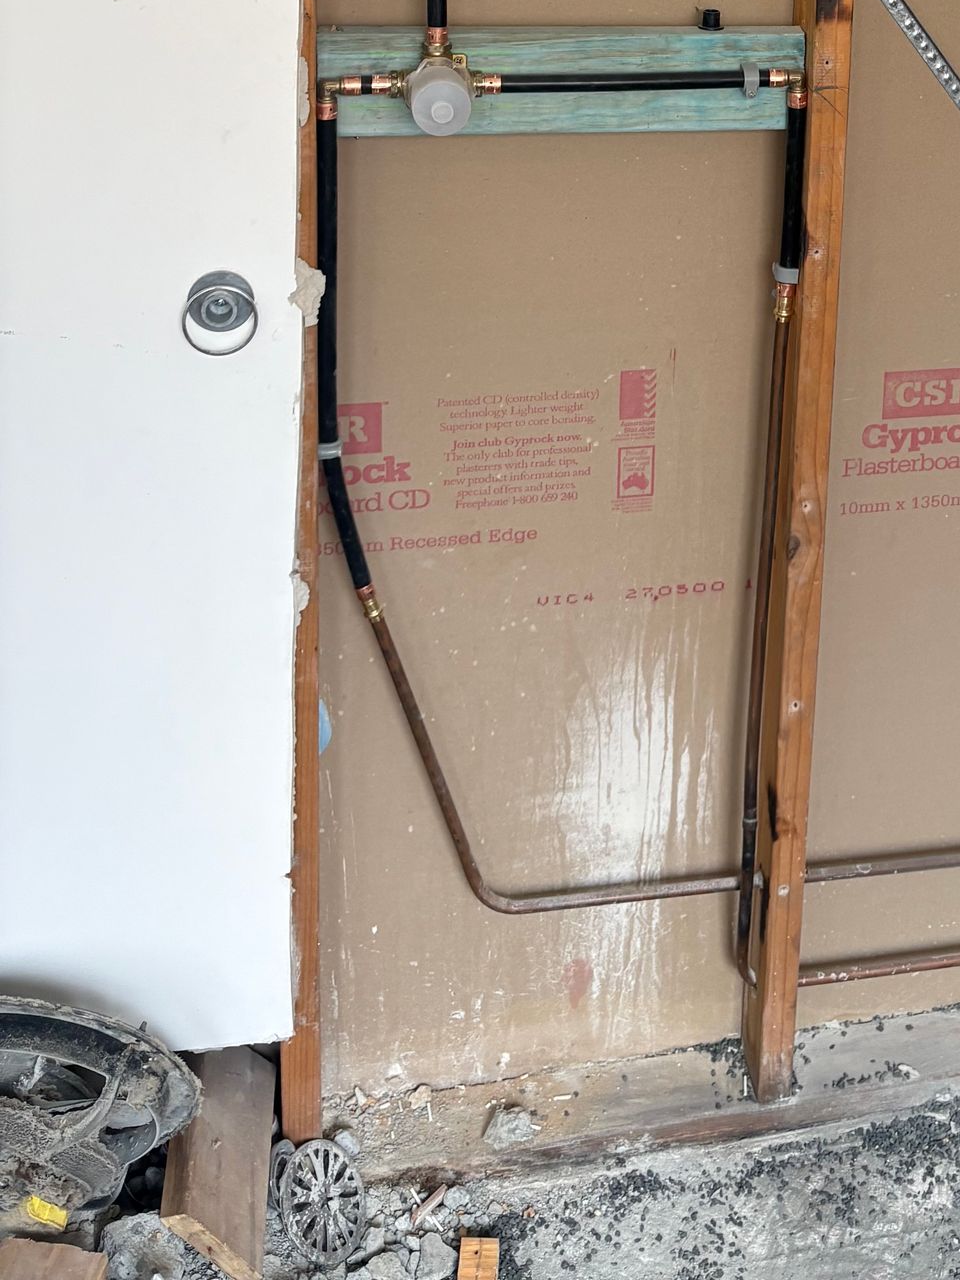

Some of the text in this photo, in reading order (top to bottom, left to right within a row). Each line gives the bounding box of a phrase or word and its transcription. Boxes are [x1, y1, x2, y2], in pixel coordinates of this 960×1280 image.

[437, 397, 480, 408] Patented
[483, 395, 502, 404] CD
[511, 404, 547, 416] Lighter
[439, 421, 482, 433] Superior
[485, 420, 512, 431] paper
[515, 419, 526, 427] to
[528, 417, 549, 426] core
[452, 439, 475, 451] Join
[478, 438, 502, 447] club
[504, 434, 553, 448] Gyprock
[444, 444, 592, 462] The only club for professional
[456, 463, 502, 476] plasterers
[505, 460, 528, 470] with
[530, 458, 556, 467] trade
[443, 467, 591, 486] new product information and
[456, 485, 491, 498] special
[493, 484, 522, 495] offers
[525, 482, 543, 491] and
[388, 489, 431, 510] CD
[455, 498, 508, 510] Freephone
[840, 501, 890, 516] 10mm
[895, 500, 906, 510] x
[389, 530, 482, 551] Recessed
[487, 528, 538, 545] Edge
